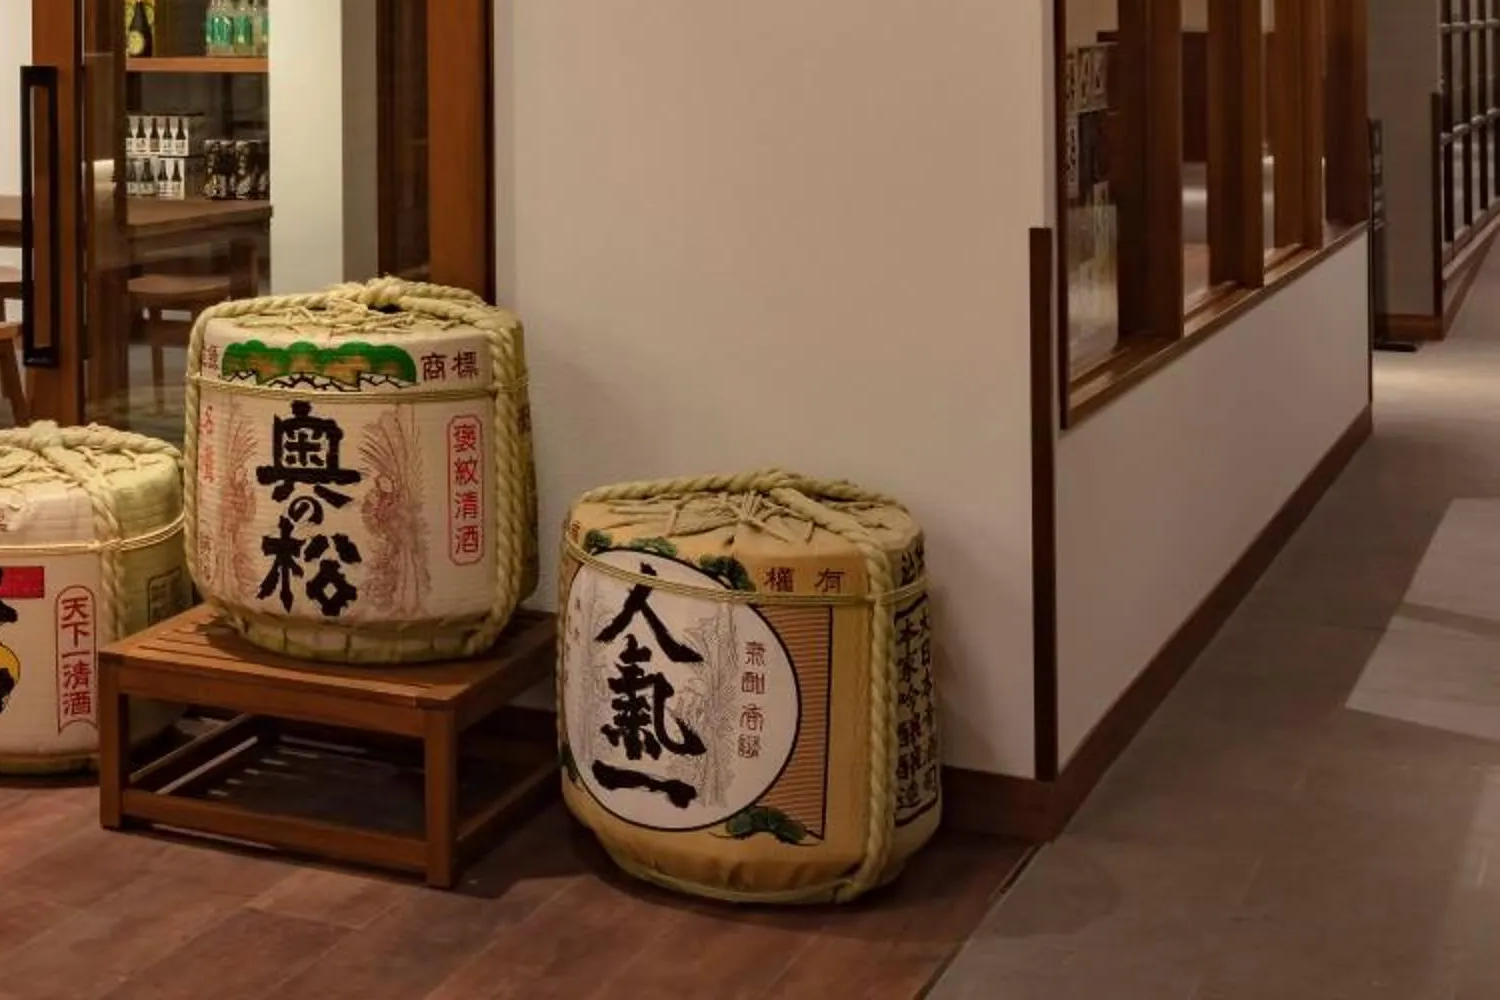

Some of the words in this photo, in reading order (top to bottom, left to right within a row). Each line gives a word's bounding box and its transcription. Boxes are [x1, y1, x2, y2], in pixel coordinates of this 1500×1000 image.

[421, 351, 480, 381] 商標
[256, 400, 363, 617] 奥の松
[61, 595, 92, 716] 天下一清酒
